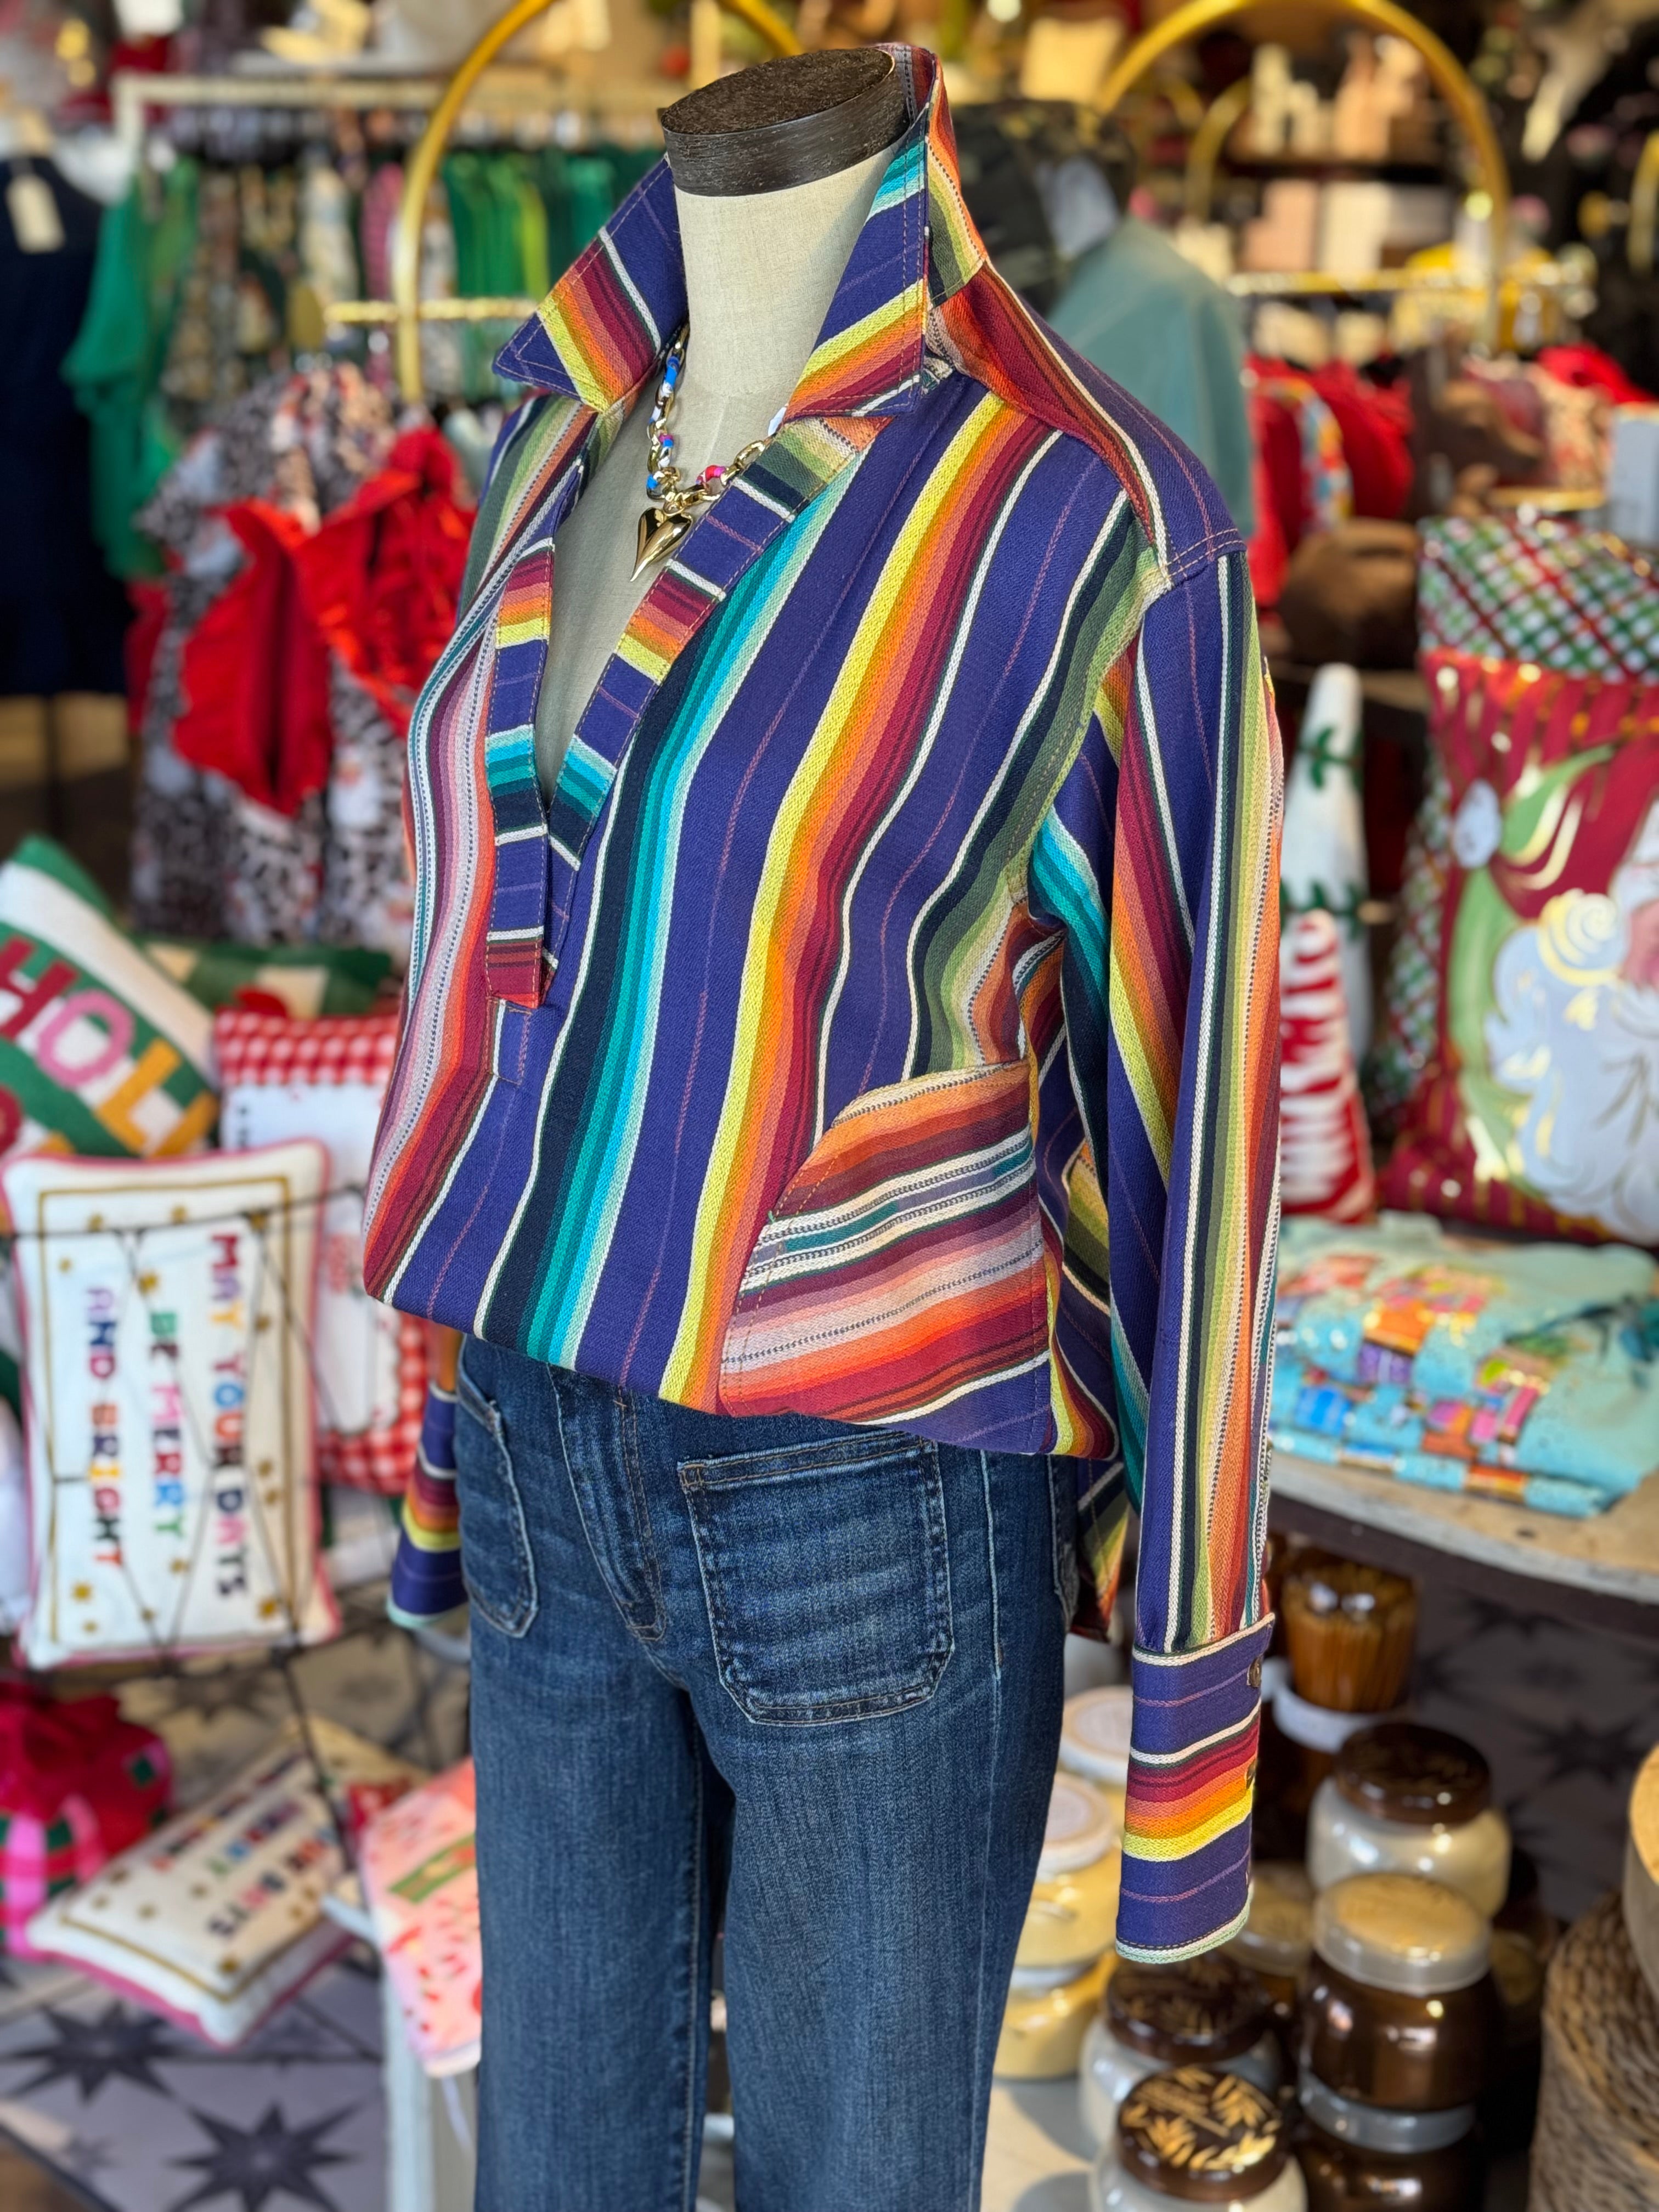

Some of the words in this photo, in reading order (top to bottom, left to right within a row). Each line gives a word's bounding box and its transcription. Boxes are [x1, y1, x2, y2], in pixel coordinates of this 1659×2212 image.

[87, 1288, 116, 1380] AND
[210, 1234, 242, 1328] MAY
[150, 1312, 178, 1362] BE
[151, 1383, 184, 1538] MERRY
[212, 1351, 245, 1467] YOUR
[89, 1403, 122, 1567] BRIGHT
[216, 1487, 246, 1595] DAYS
